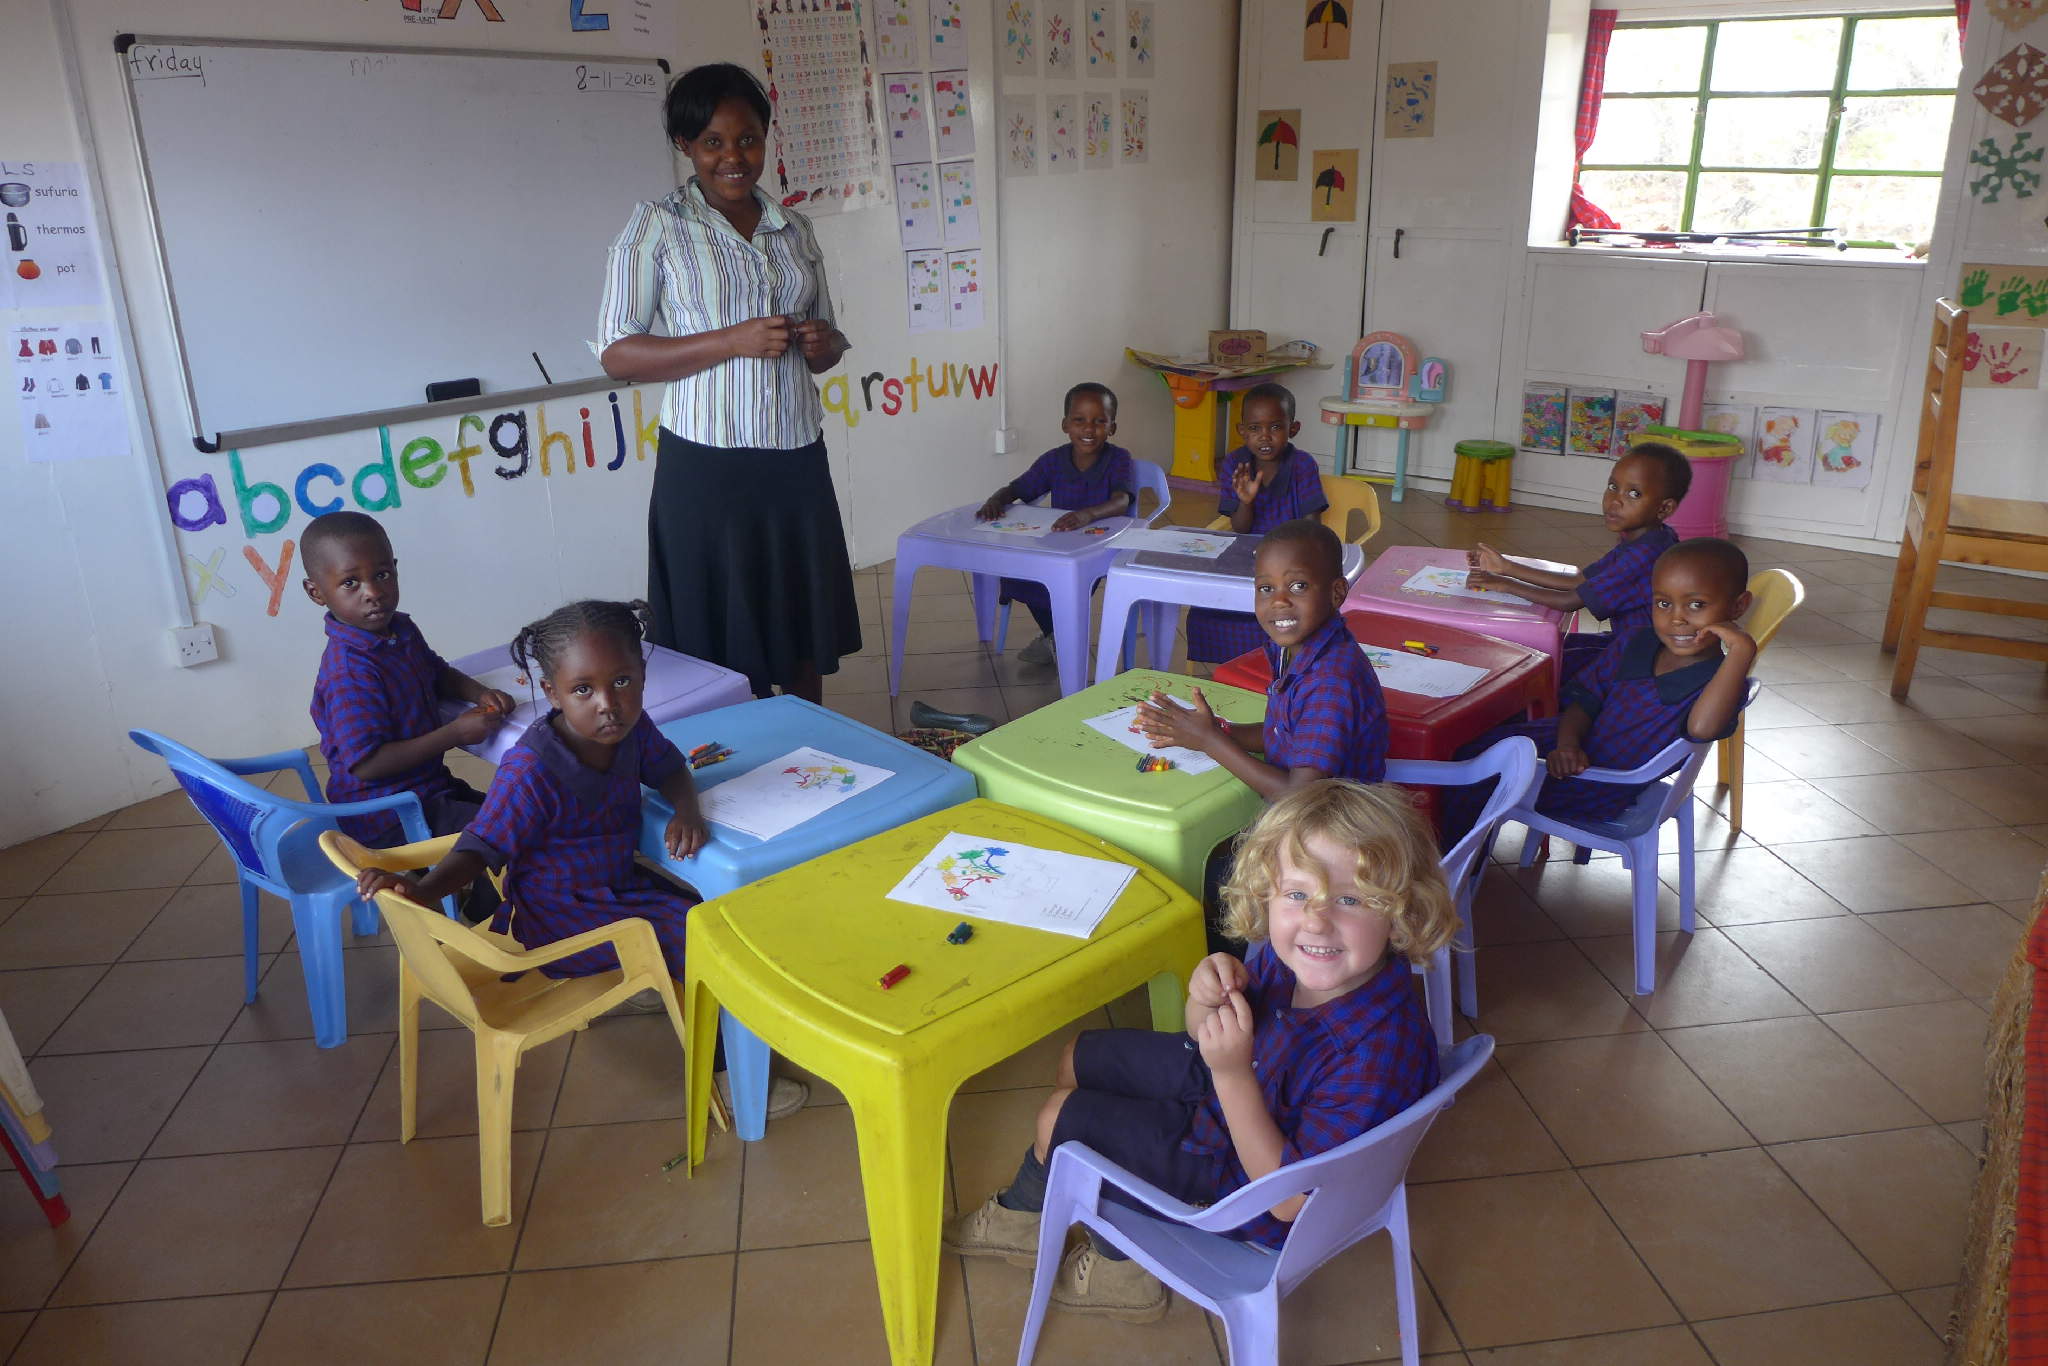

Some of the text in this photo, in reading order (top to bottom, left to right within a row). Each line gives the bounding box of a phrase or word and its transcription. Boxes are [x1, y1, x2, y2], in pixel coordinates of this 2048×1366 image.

[575, 65, 656, 90] 8-11-2013
[34, 186, 79, 197] sufuria
[37, 224, 86, 235] thermos
[57, 263, 76, 277] pot
